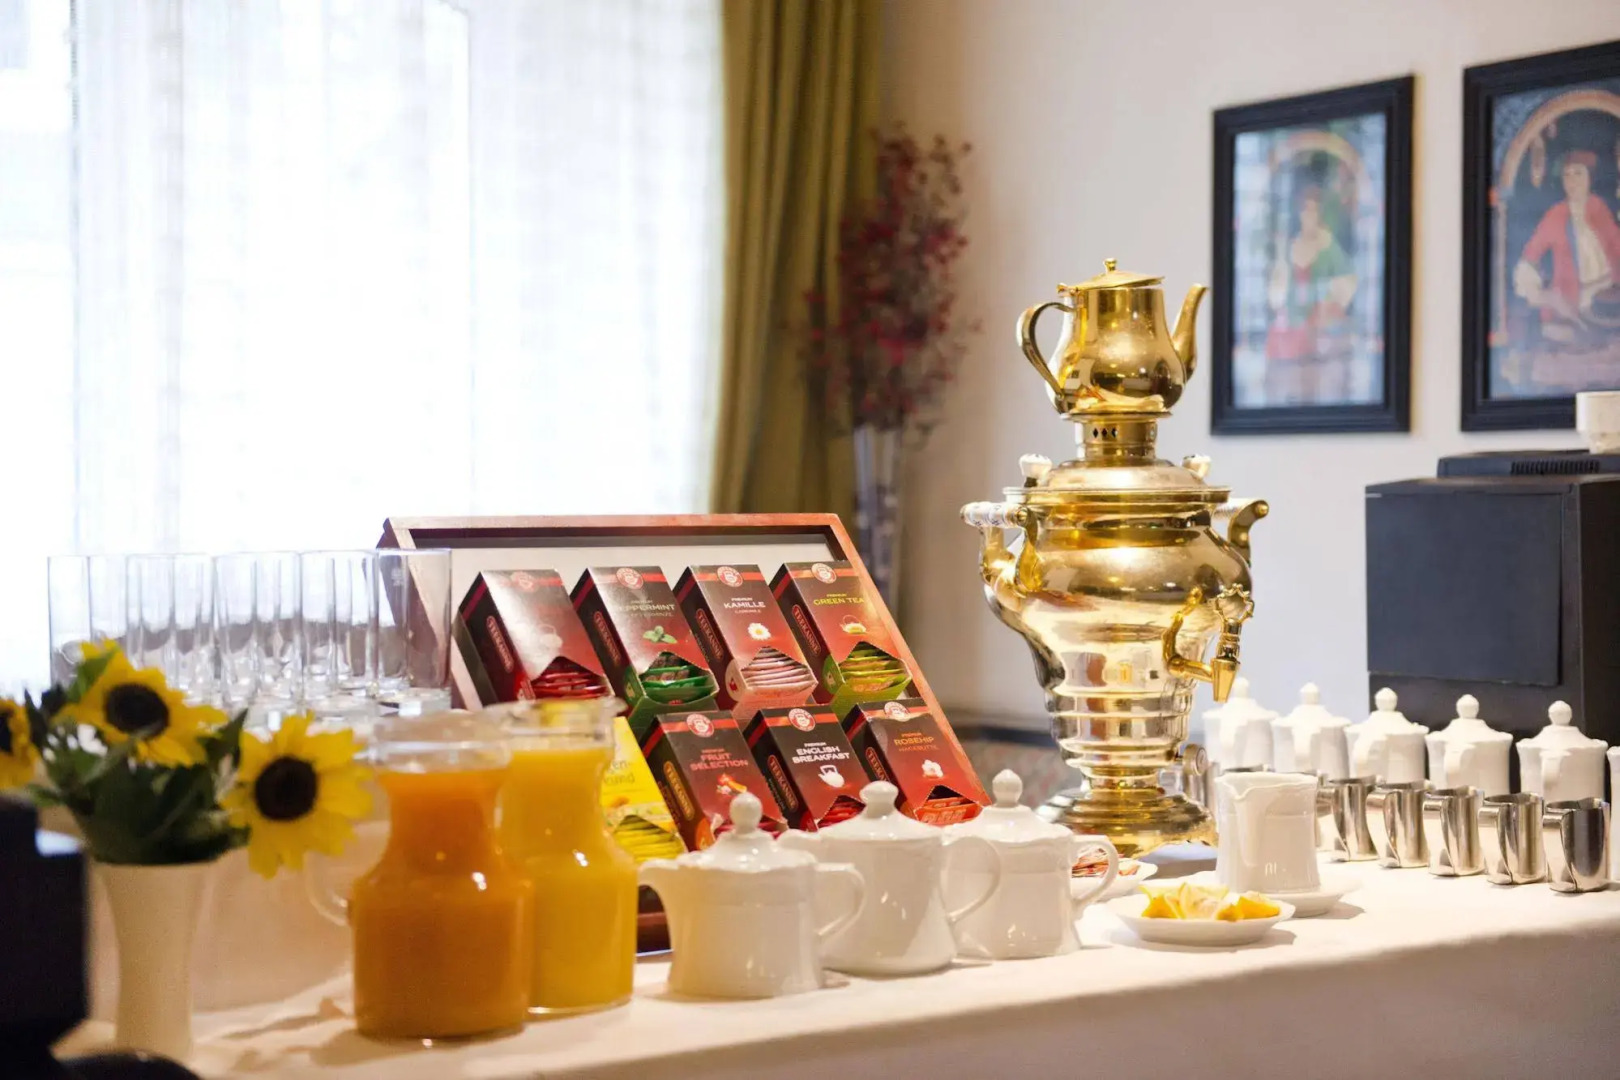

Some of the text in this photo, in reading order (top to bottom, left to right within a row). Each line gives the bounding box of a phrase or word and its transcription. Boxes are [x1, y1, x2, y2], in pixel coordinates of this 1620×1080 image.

[723, 601, 766, 609] KAMILLE
[813, 597, 846, 606] GREEN
[794, 608, 820, 654] TEEKANNE
[893, 736, 934, 746] ROSEHIP
[796, 746, 841, 755] ENGLISH
[701, 752, 733, 761] FRUIT
[791, 752, 850, 764] BREAKFAST
[689, 759, 749, 771] SELECTION
